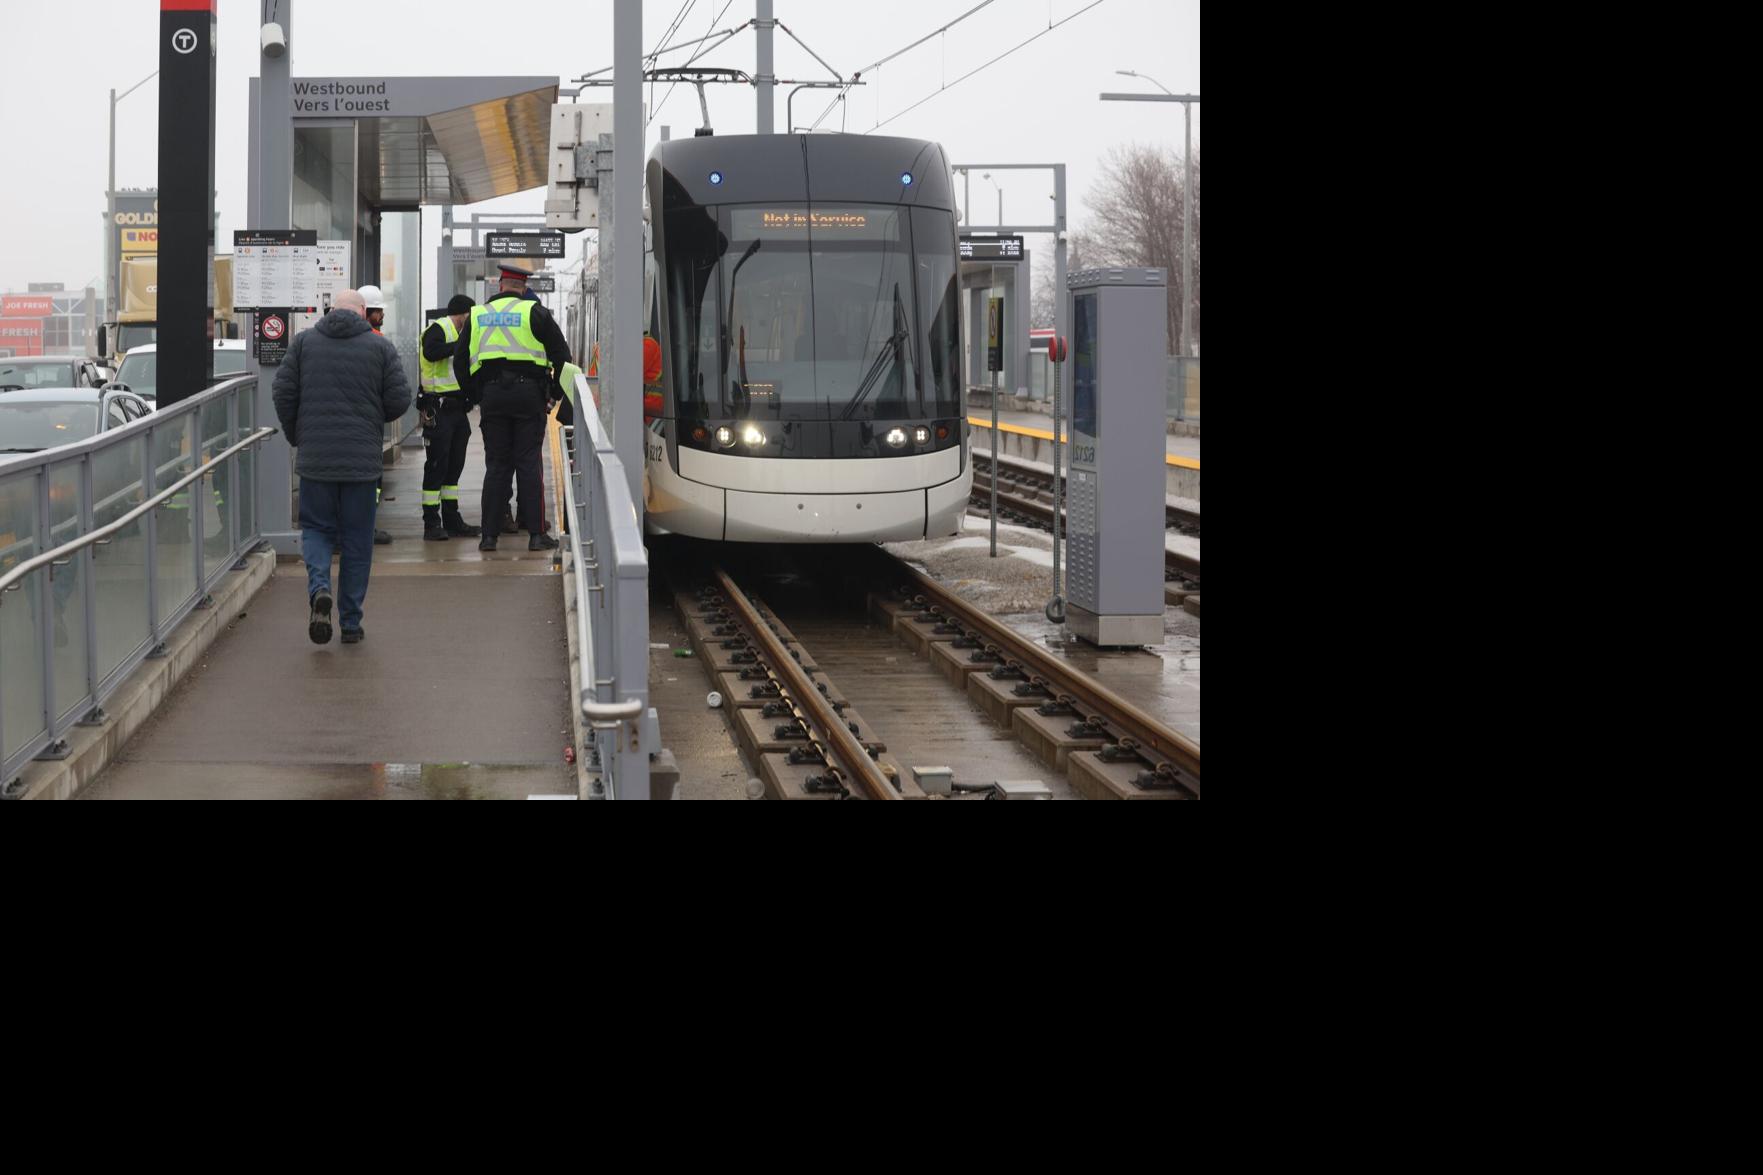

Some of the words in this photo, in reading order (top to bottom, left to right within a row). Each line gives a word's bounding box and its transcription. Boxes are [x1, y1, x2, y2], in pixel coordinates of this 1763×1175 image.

[179, 35, 191, 48] T
[294, 82, 386, 95] Westbound
[294, 99, 329, 111] Vers
[764, 213, 790, 227] Not
[810, 213, 865, 227] Service
[2, 328, 38, 337] FRESH
